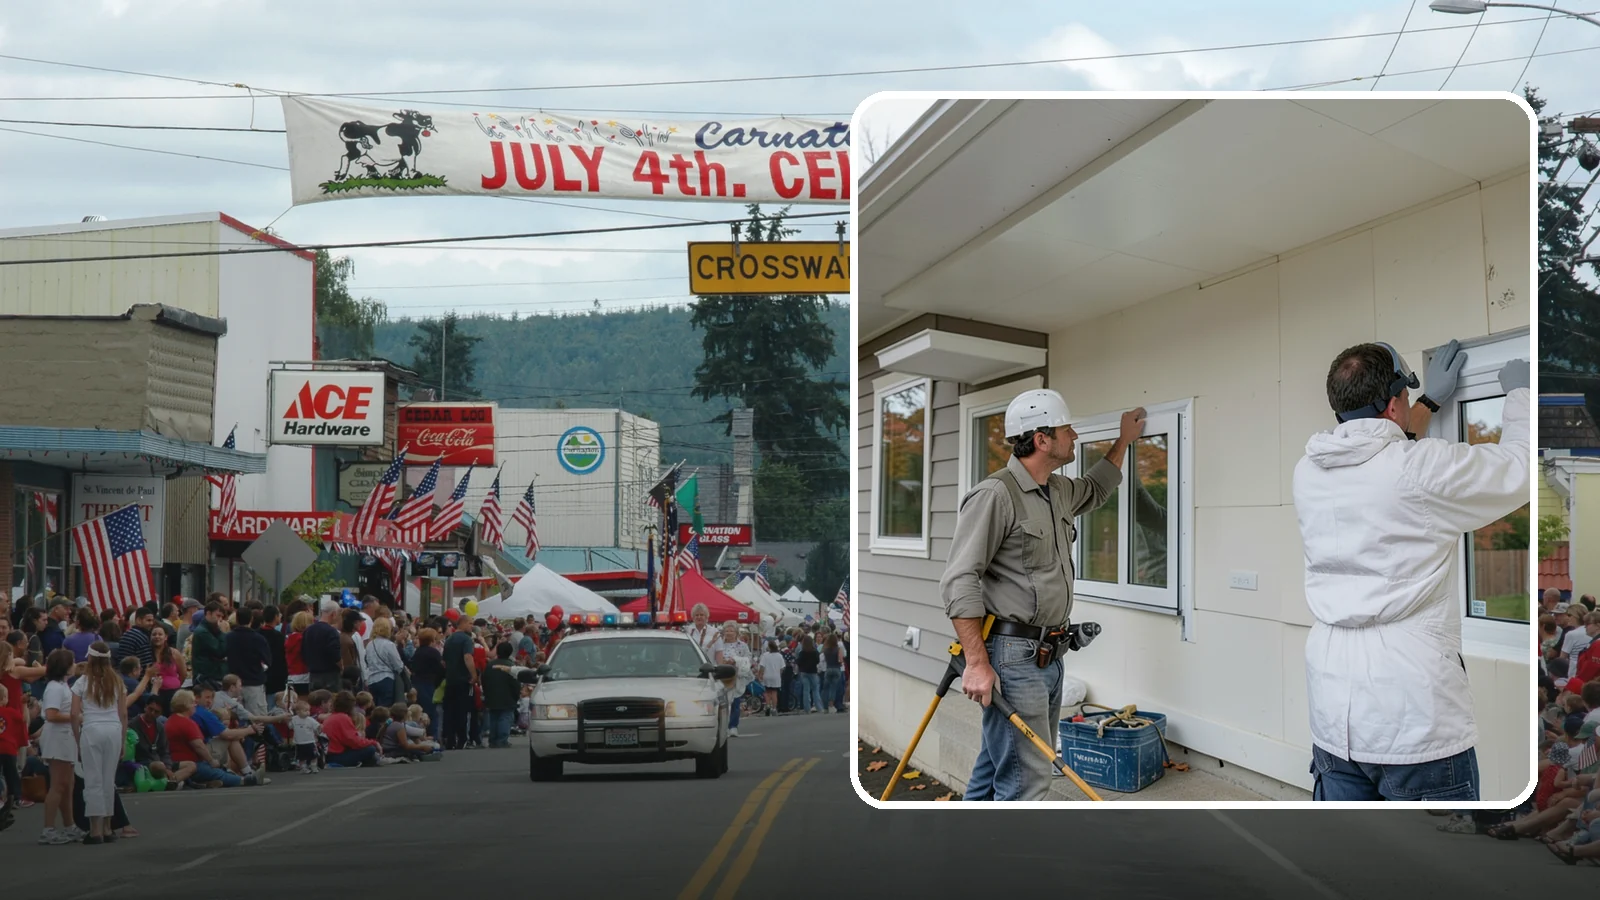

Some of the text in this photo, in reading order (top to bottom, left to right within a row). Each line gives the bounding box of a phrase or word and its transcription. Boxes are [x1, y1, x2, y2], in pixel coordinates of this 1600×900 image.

[695, 121, 850, 149] Carnat
[481, 141, 605, 192] JULY
[632, 150, 746, 198] 4th.
[697, 254, 850, 280] CROSSWA
[283, 380, 373, 419] ACE
[406, 409, 452, 422] CEDAR
[283, 421, 371, 436] Hardware
[416, 428, 476, 446] Coca-Cola
[95, 484, 124, 495] Vincent
[126, 486, 136, 495] de
[137, 486, 155, 495] Paul
[213, 516, 330, 536] HARDARE
[688, 527, 741, 535] CRNATION
[699, 535, 730, 543] GLASS
